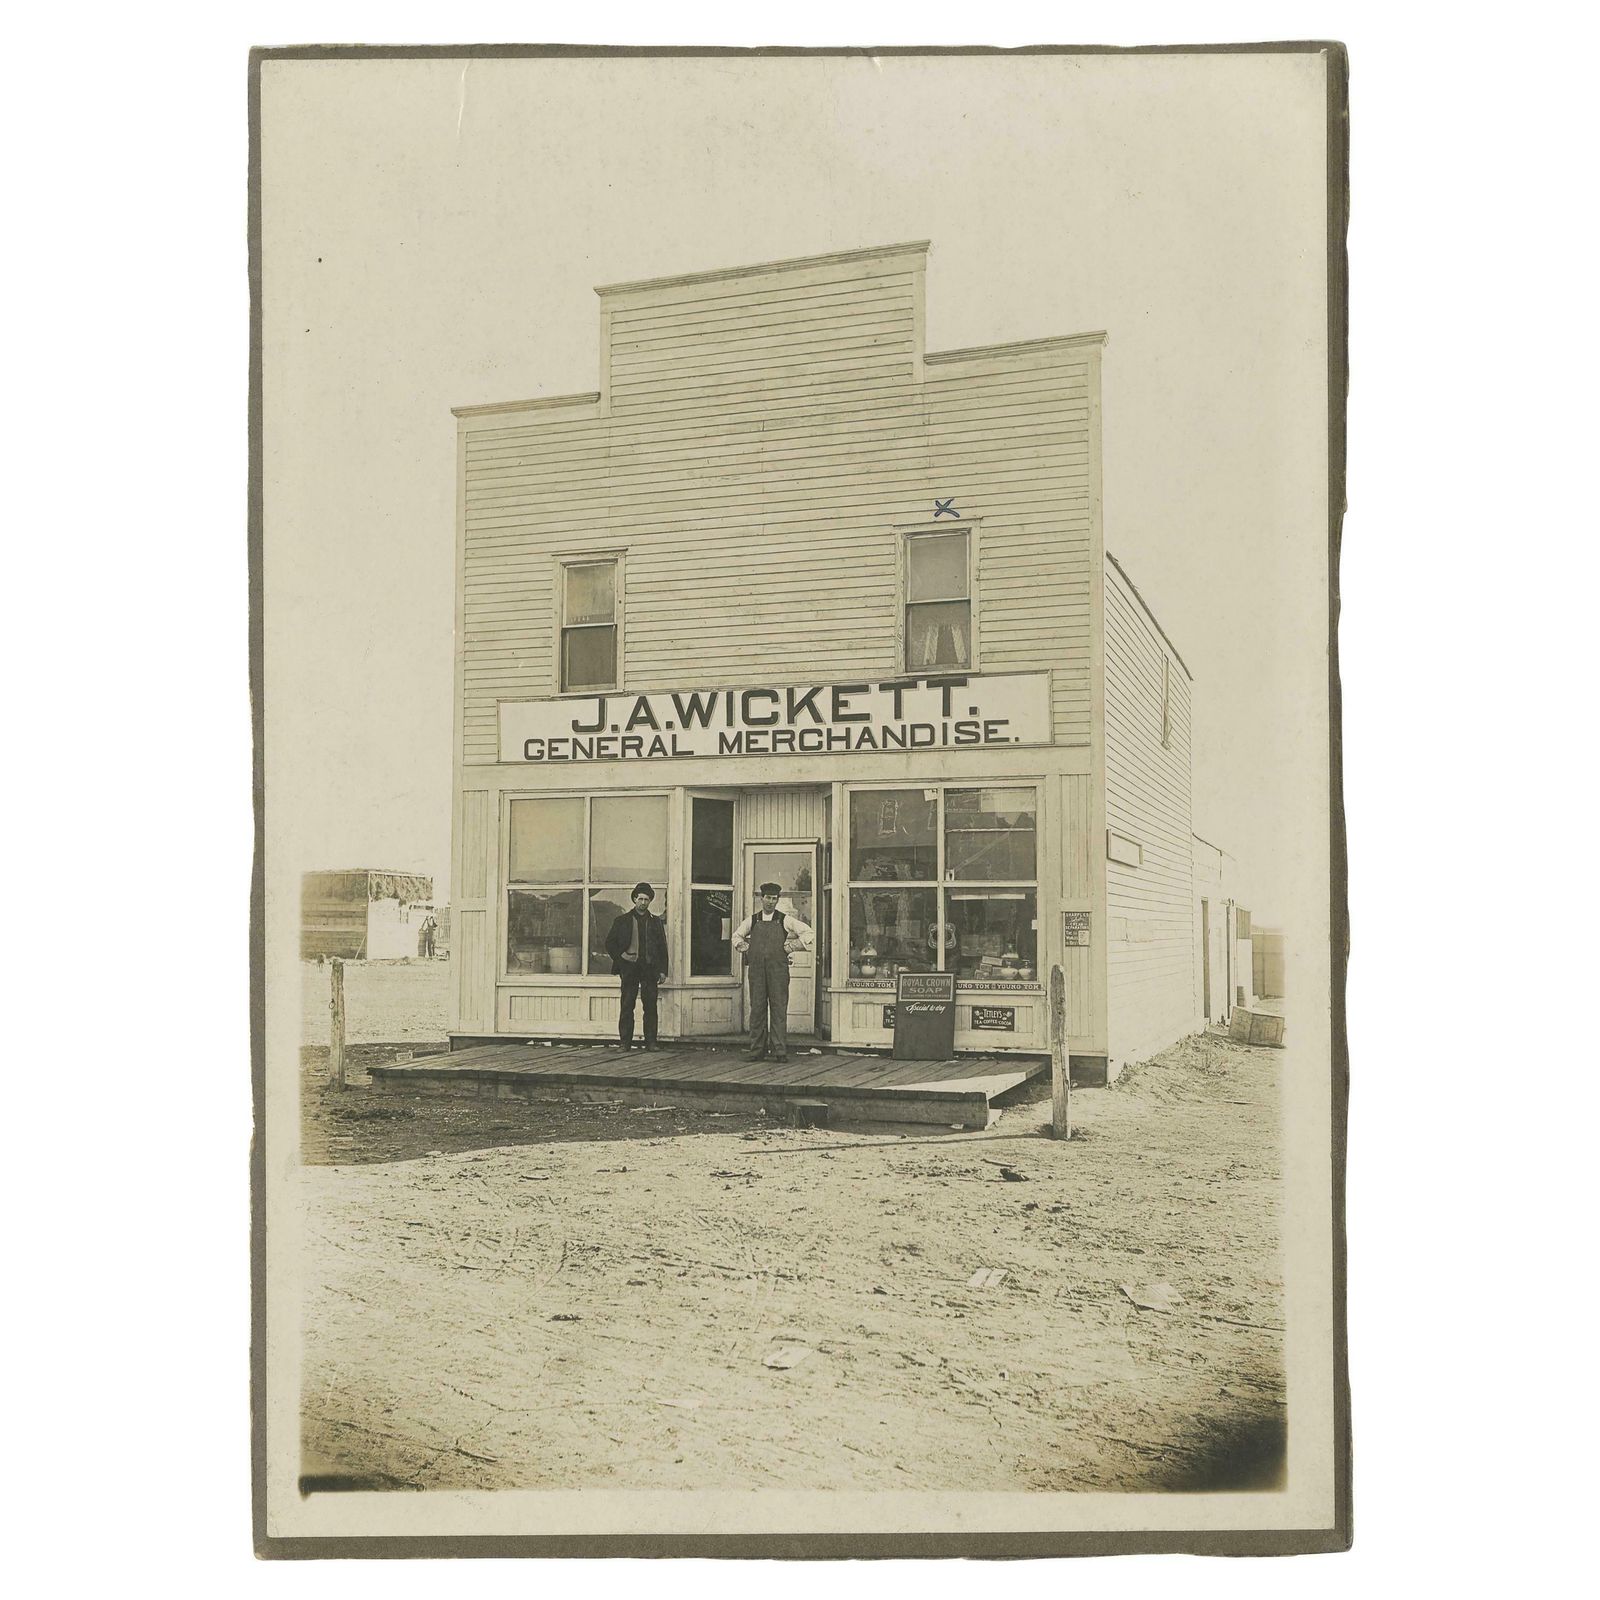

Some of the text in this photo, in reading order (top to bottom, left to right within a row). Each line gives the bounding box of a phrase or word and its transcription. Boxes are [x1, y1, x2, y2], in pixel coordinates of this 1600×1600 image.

[524, 719, 1020, 761] GENERAL MERCHANDISE.
[902, 978, 951, 987] ROYAL CROWN
